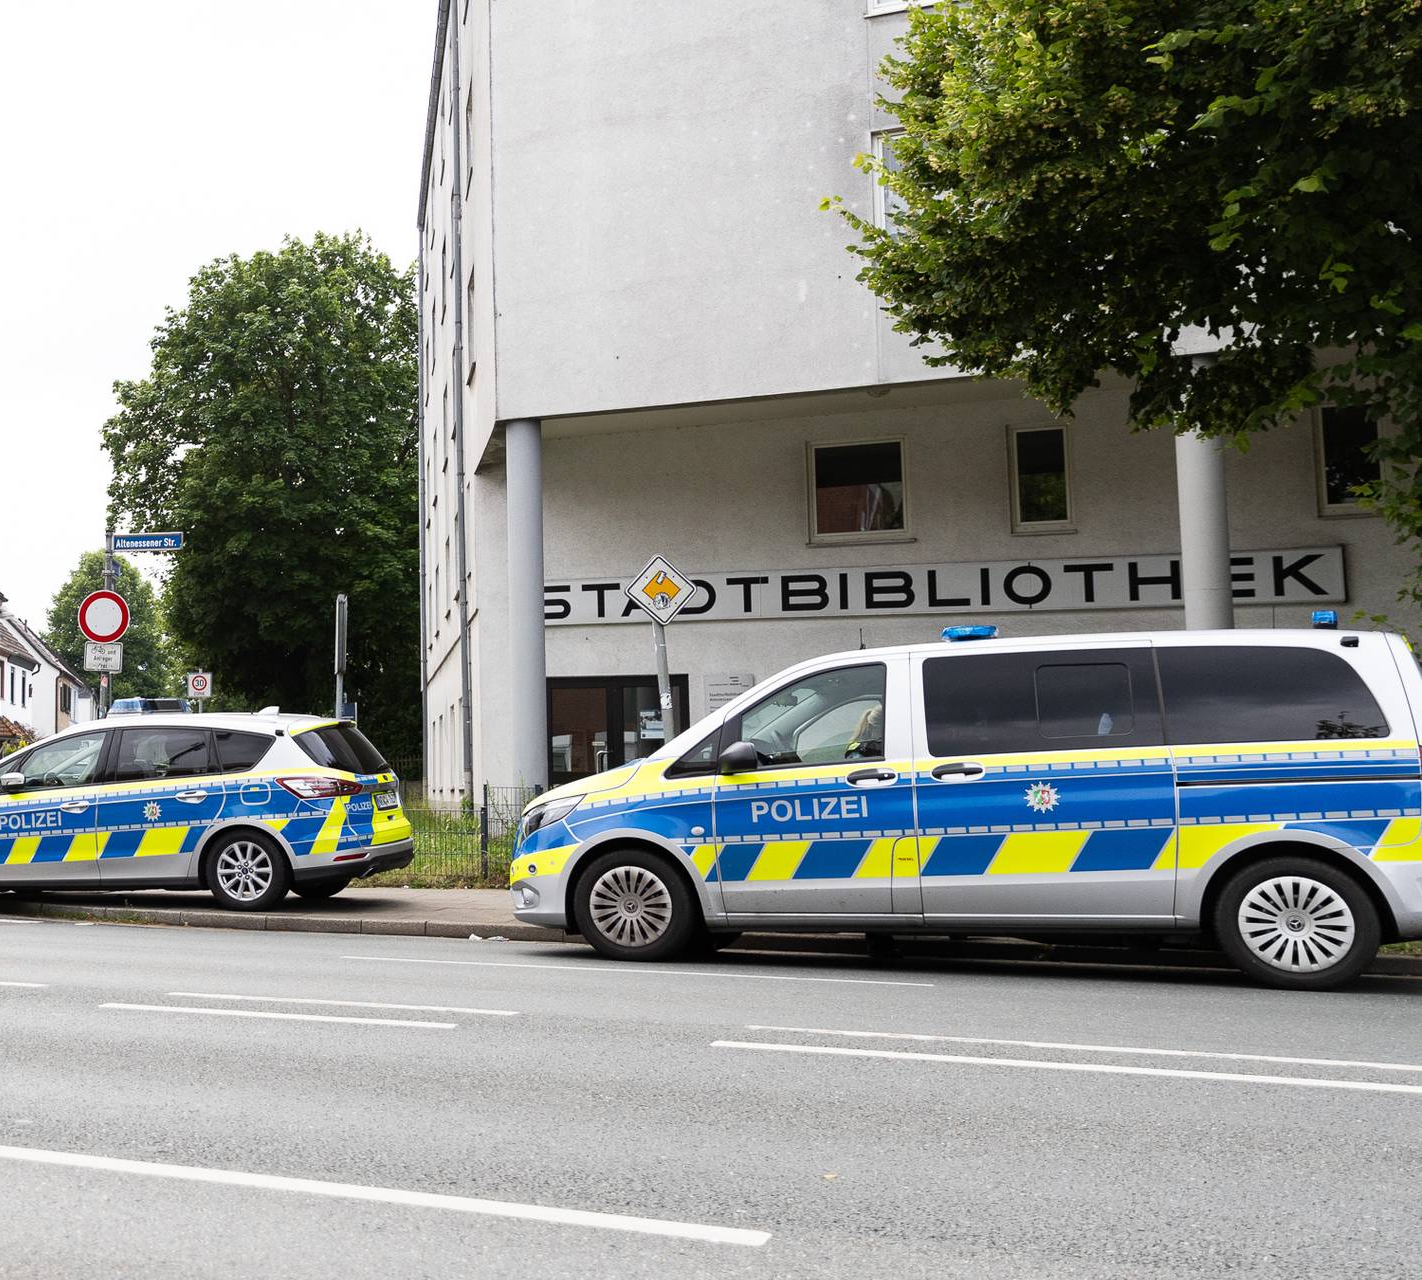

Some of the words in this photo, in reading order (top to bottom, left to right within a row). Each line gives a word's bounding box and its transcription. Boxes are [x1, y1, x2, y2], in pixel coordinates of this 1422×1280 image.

[115, 537, 163, 549] Altenessener
[163, 536, 177, 547] Str.
[195, 679, 205, 687] 30
[346, 801, 373, 812] POLIZEI
[751, 795, 868, 823] POLIZEI
